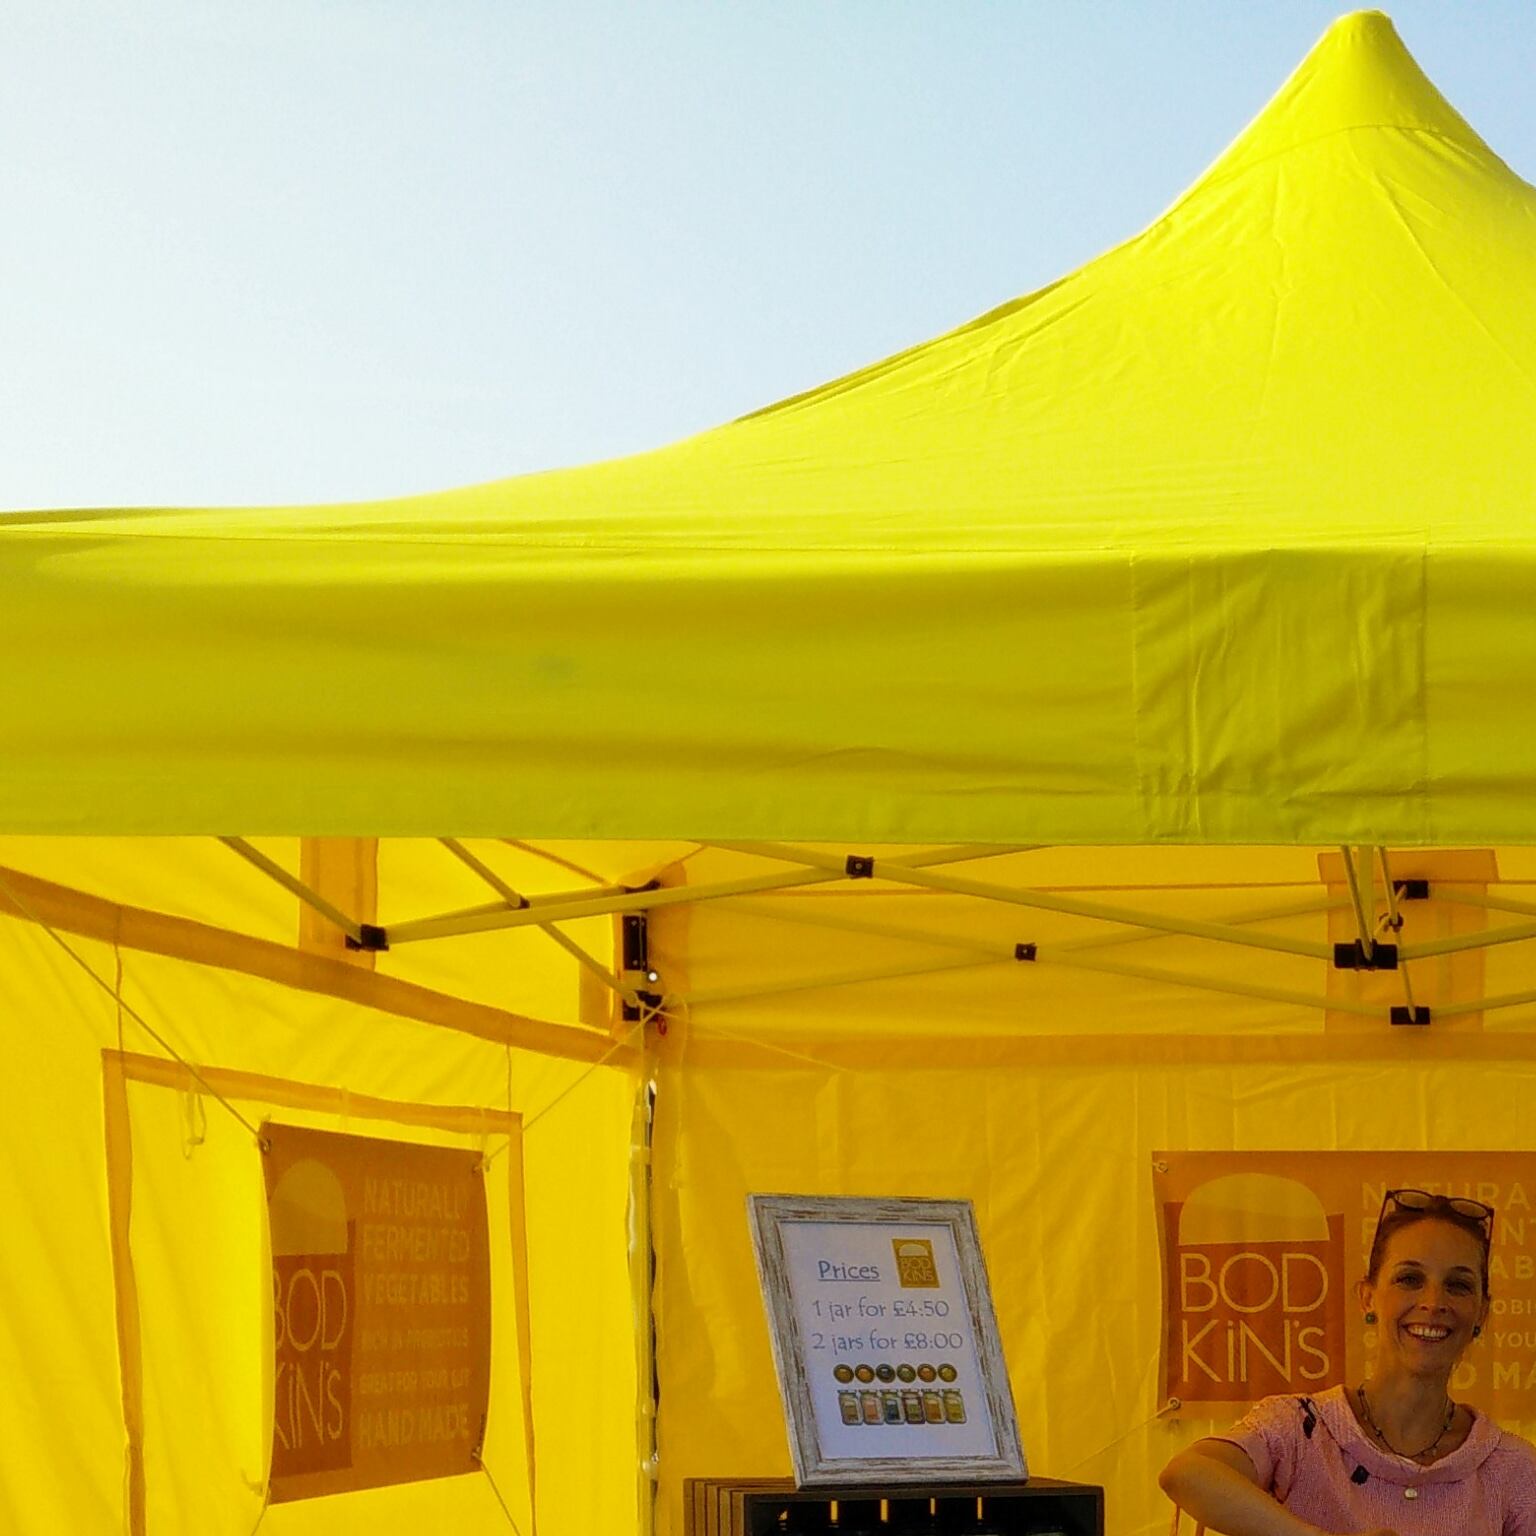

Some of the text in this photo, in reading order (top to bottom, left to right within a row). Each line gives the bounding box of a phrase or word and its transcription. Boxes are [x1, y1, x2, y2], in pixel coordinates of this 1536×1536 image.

[818, 1260, 880, 1280] Prices
[1180, 1252, 1329, 1313] BOD
[812, 1301, 821, 1316] 1
[829, 1301, 852, 1322] jar
[858, 1296, 886, 1317] for
[812, 1333, 826, 1349] 2
[832, 1334, 863, 1355] jars
[870, 1329, 897, 1349] for
